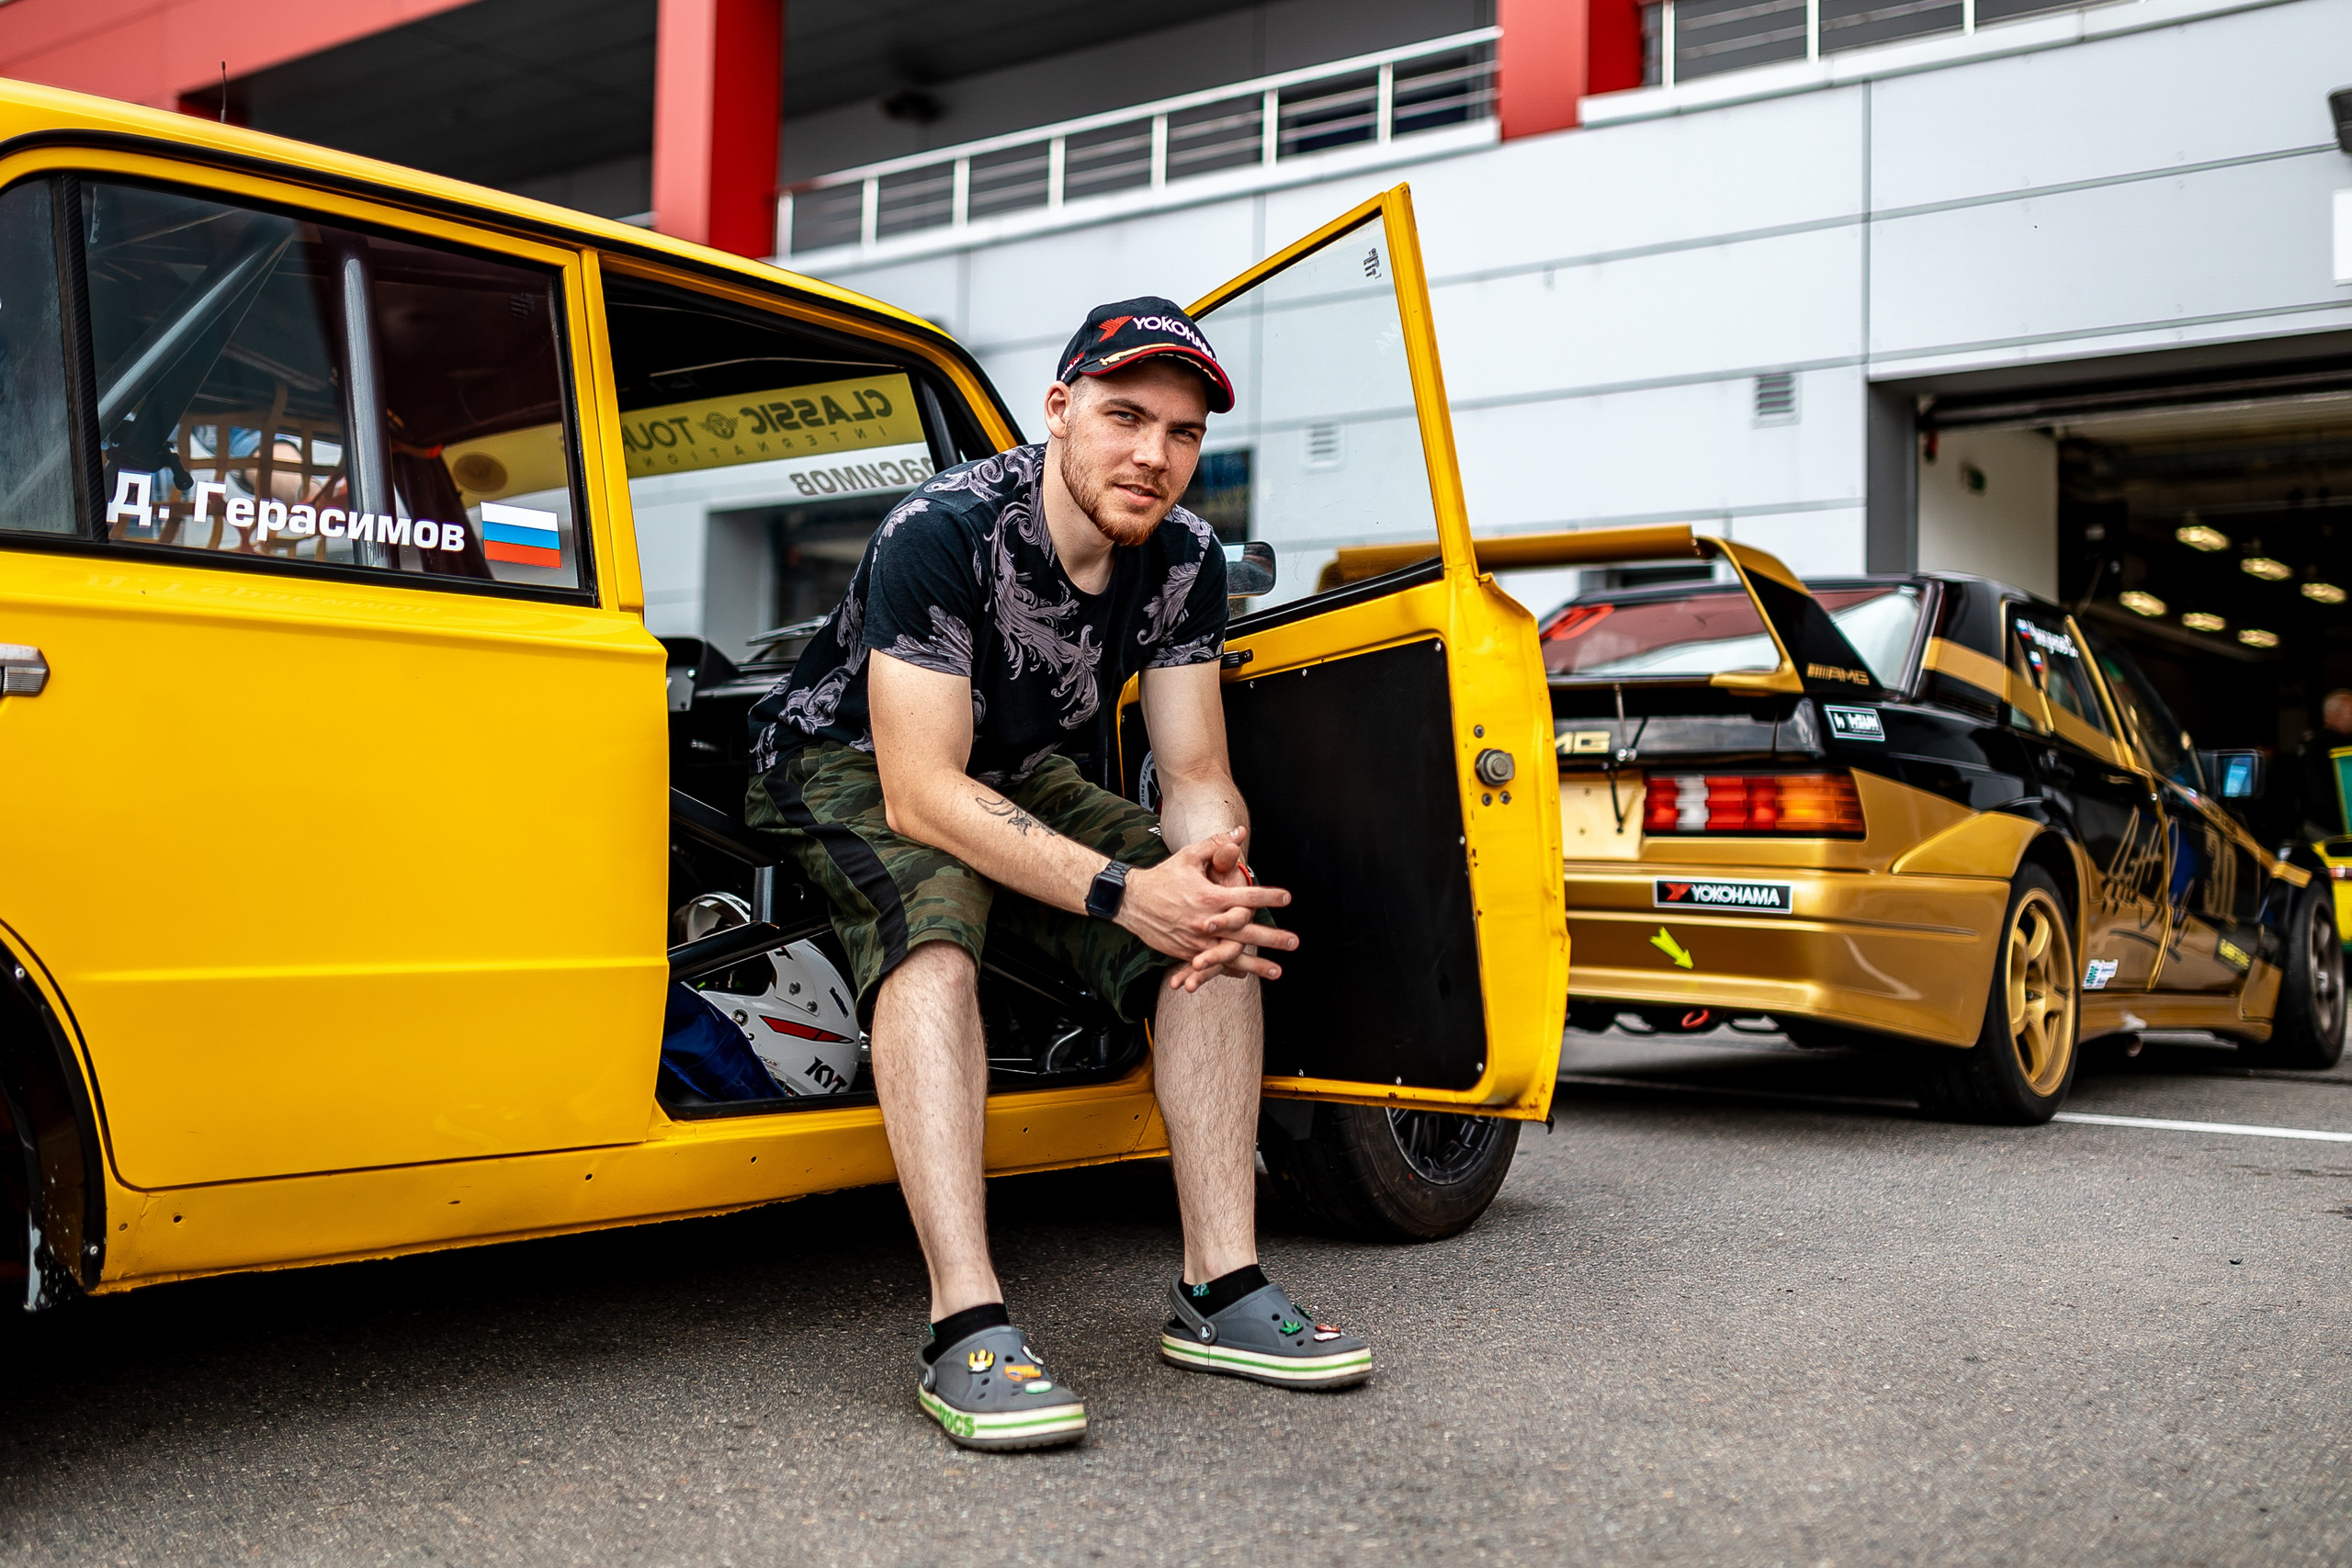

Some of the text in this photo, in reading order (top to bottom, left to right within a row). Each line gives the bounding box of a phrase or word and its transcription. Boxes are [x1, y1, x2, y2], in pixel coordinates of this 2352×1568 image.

[1132, 315, 1216, 362] YOKOHAM
[106, 469, 466, 552] Д. Герасимов
[1690, 884, 1781, 907] YOKOHAMA
[804, 1055, 848, 1095] KYT
